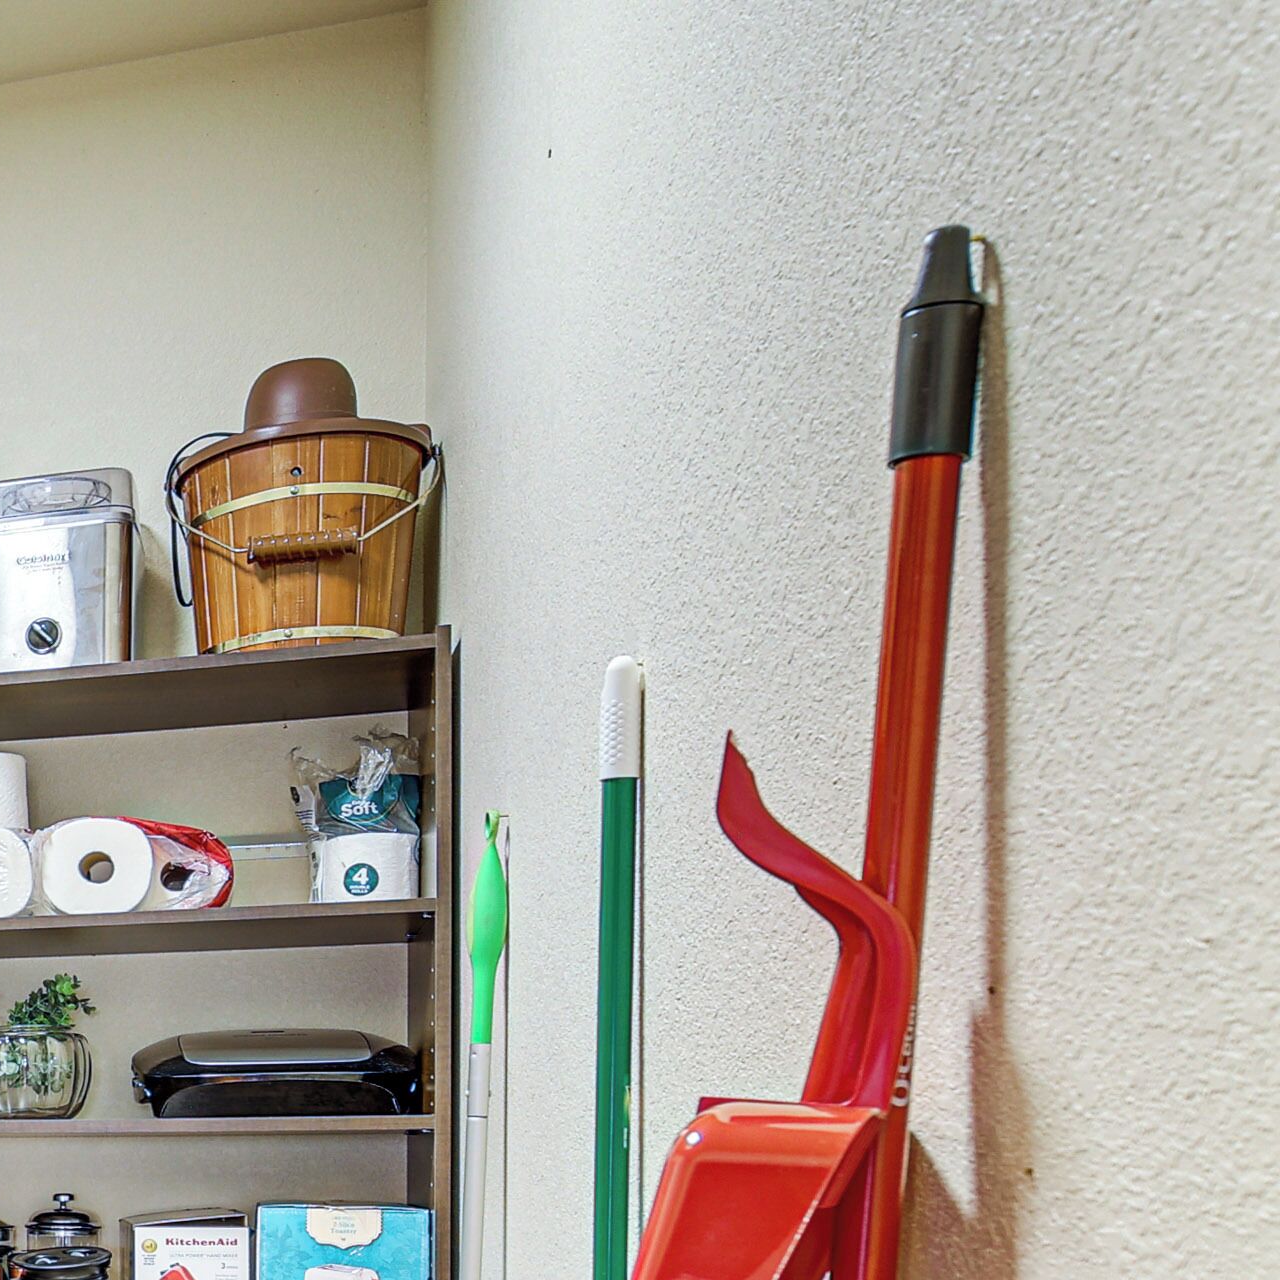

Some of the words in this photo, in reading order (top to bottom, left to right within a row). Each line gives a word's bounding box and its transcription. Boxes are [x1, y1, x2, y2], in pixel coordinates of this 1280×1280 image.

[341, 801, 379, 817] Soft
[352, 867, 369, 885] 4
[165, 1238, 238, 1247] KitchenAid
